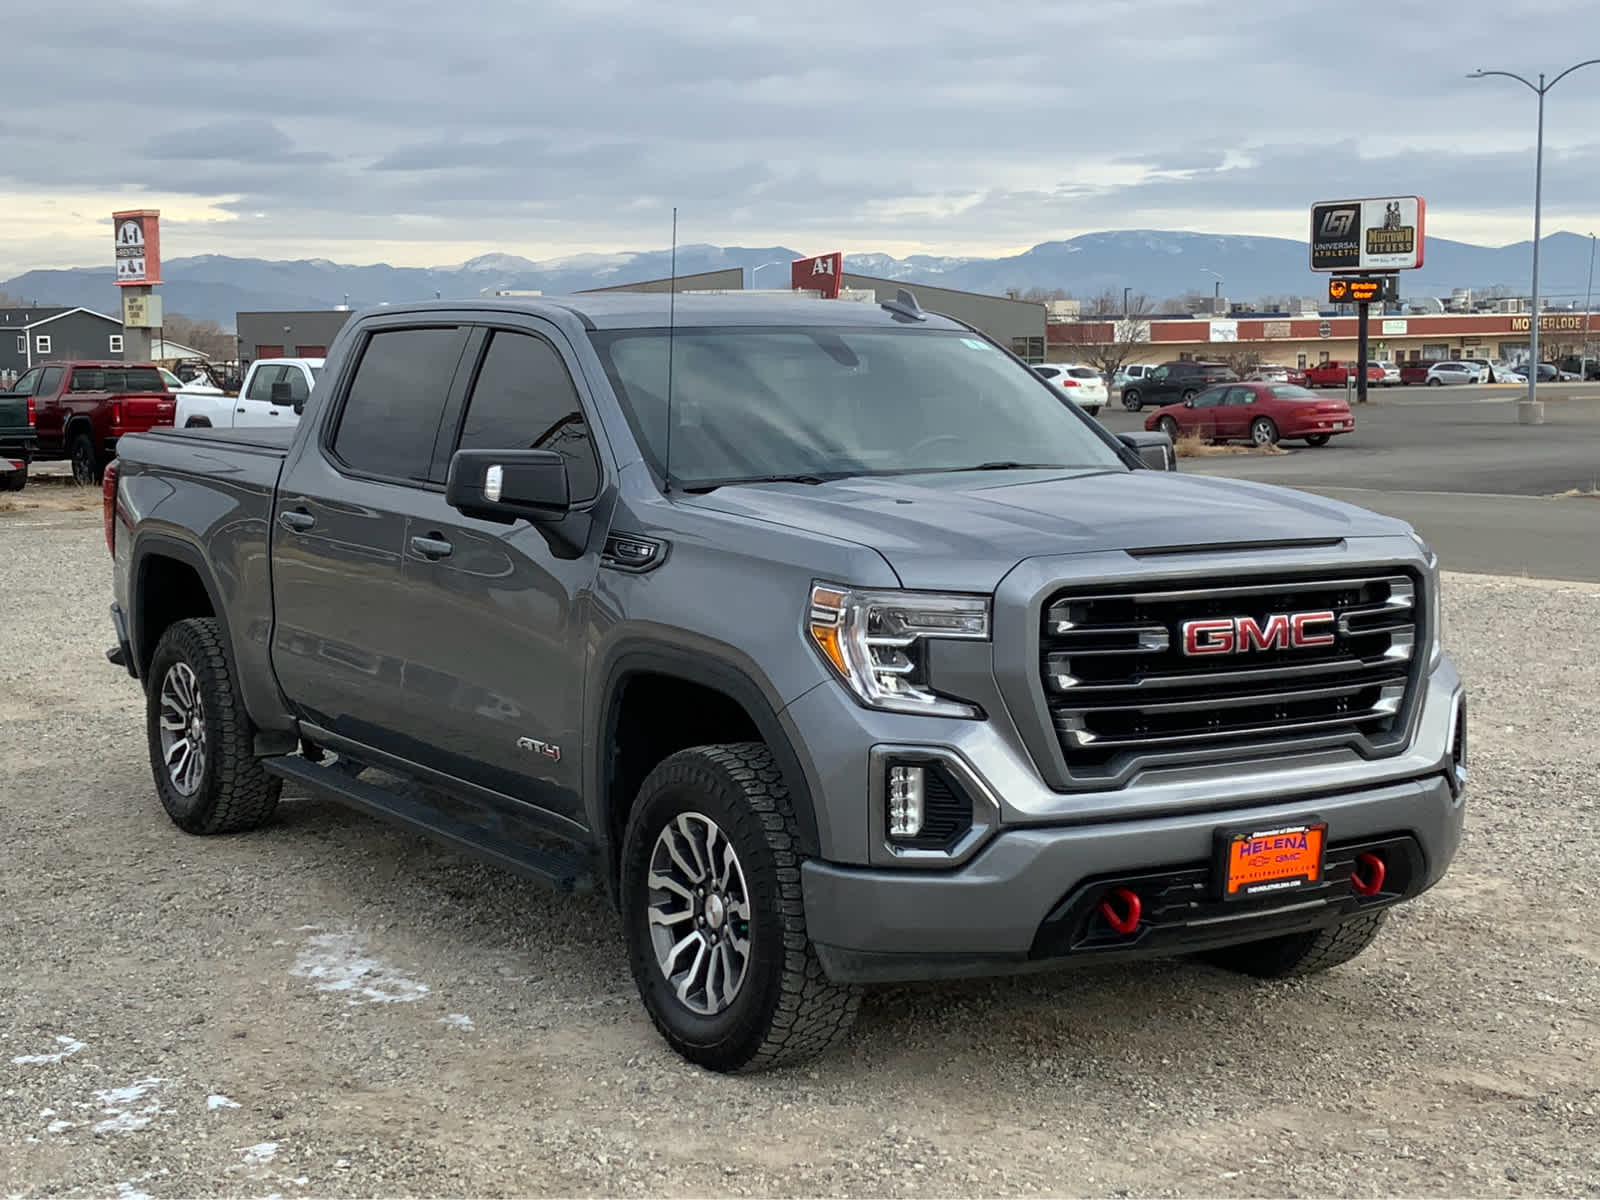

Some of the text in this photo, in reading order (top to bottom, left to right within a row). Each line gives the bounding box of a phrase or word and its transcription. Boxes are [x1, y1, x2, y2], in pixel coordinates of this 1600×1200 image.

[1314, 241, 1359, 250] UNIVERSAL
[1368, 243, 1412, 253] FITNESS
[1314, 249, 1360, 257] ATHLETIC
[1512, 317, 1581, 330] MOHERLODE
[1183, 611, 1335, 656] GMC
[516, 736, 560, 762] AT4
[1240, 836, 1308, 858] HELENA
